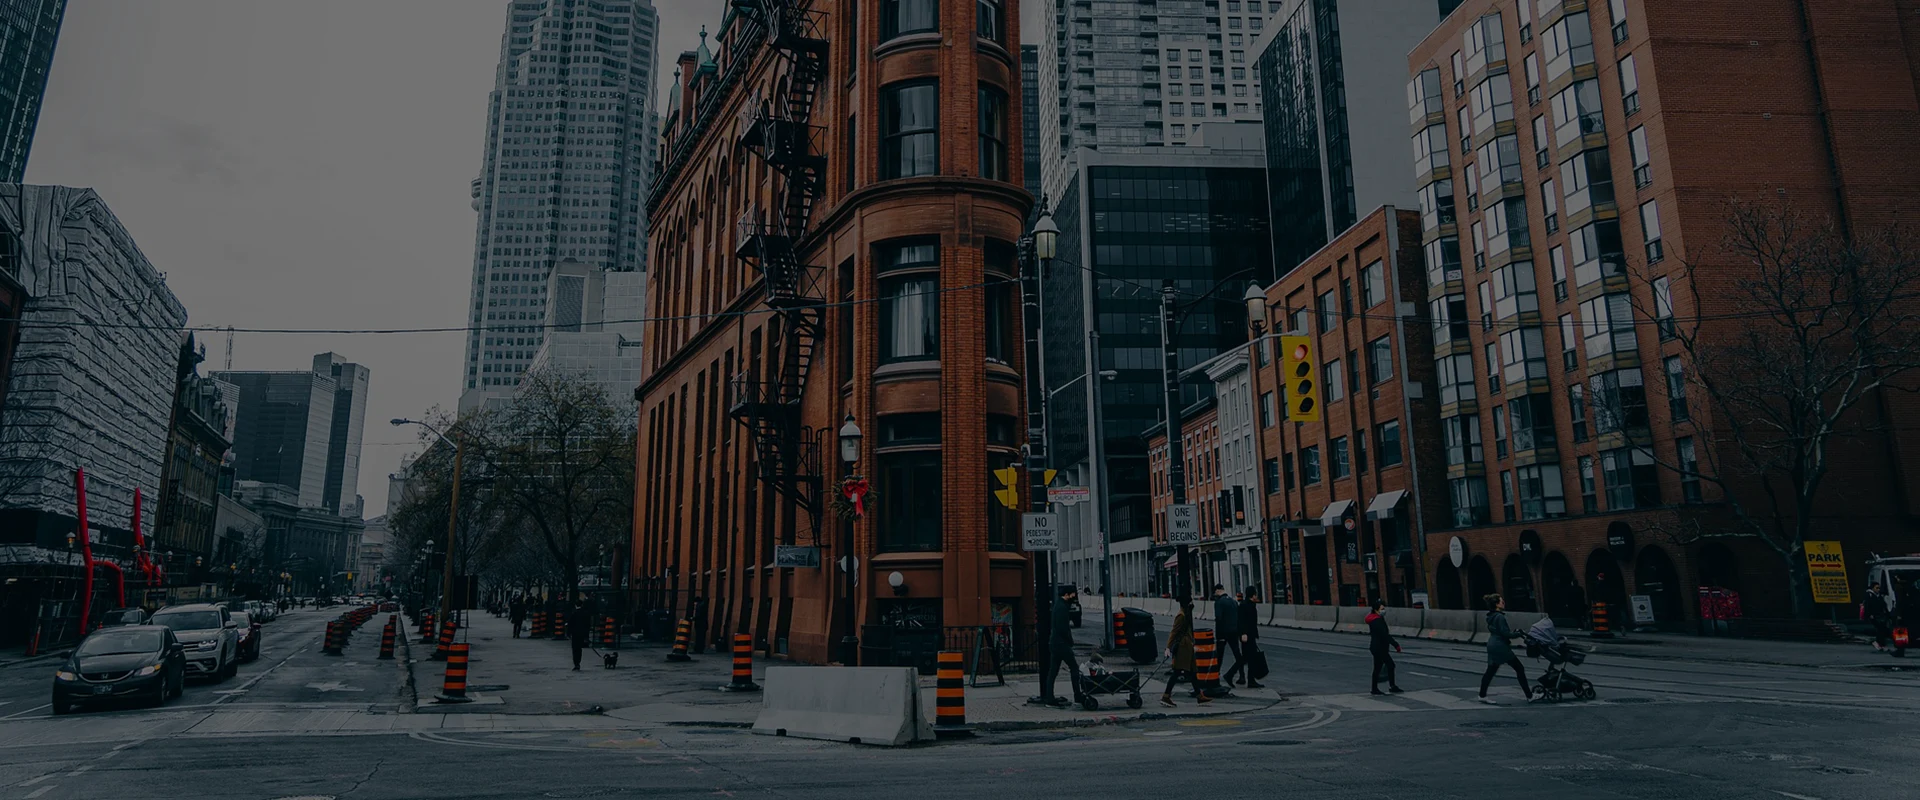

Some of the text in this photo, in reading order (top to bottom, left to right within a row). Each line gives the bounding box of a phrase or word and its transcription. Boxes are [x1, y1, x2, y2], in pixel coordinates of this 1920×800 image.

[1174, 507, 1191, 517] ONE
[1034, 517, 1047, 528] NO
[1175, 519, 1191, 529] WAY
[1170, 531, 1198, 541] BEGINS
[1347, 542, 1356, 551] 52
[1808, 553, 1841, 562] PARK
